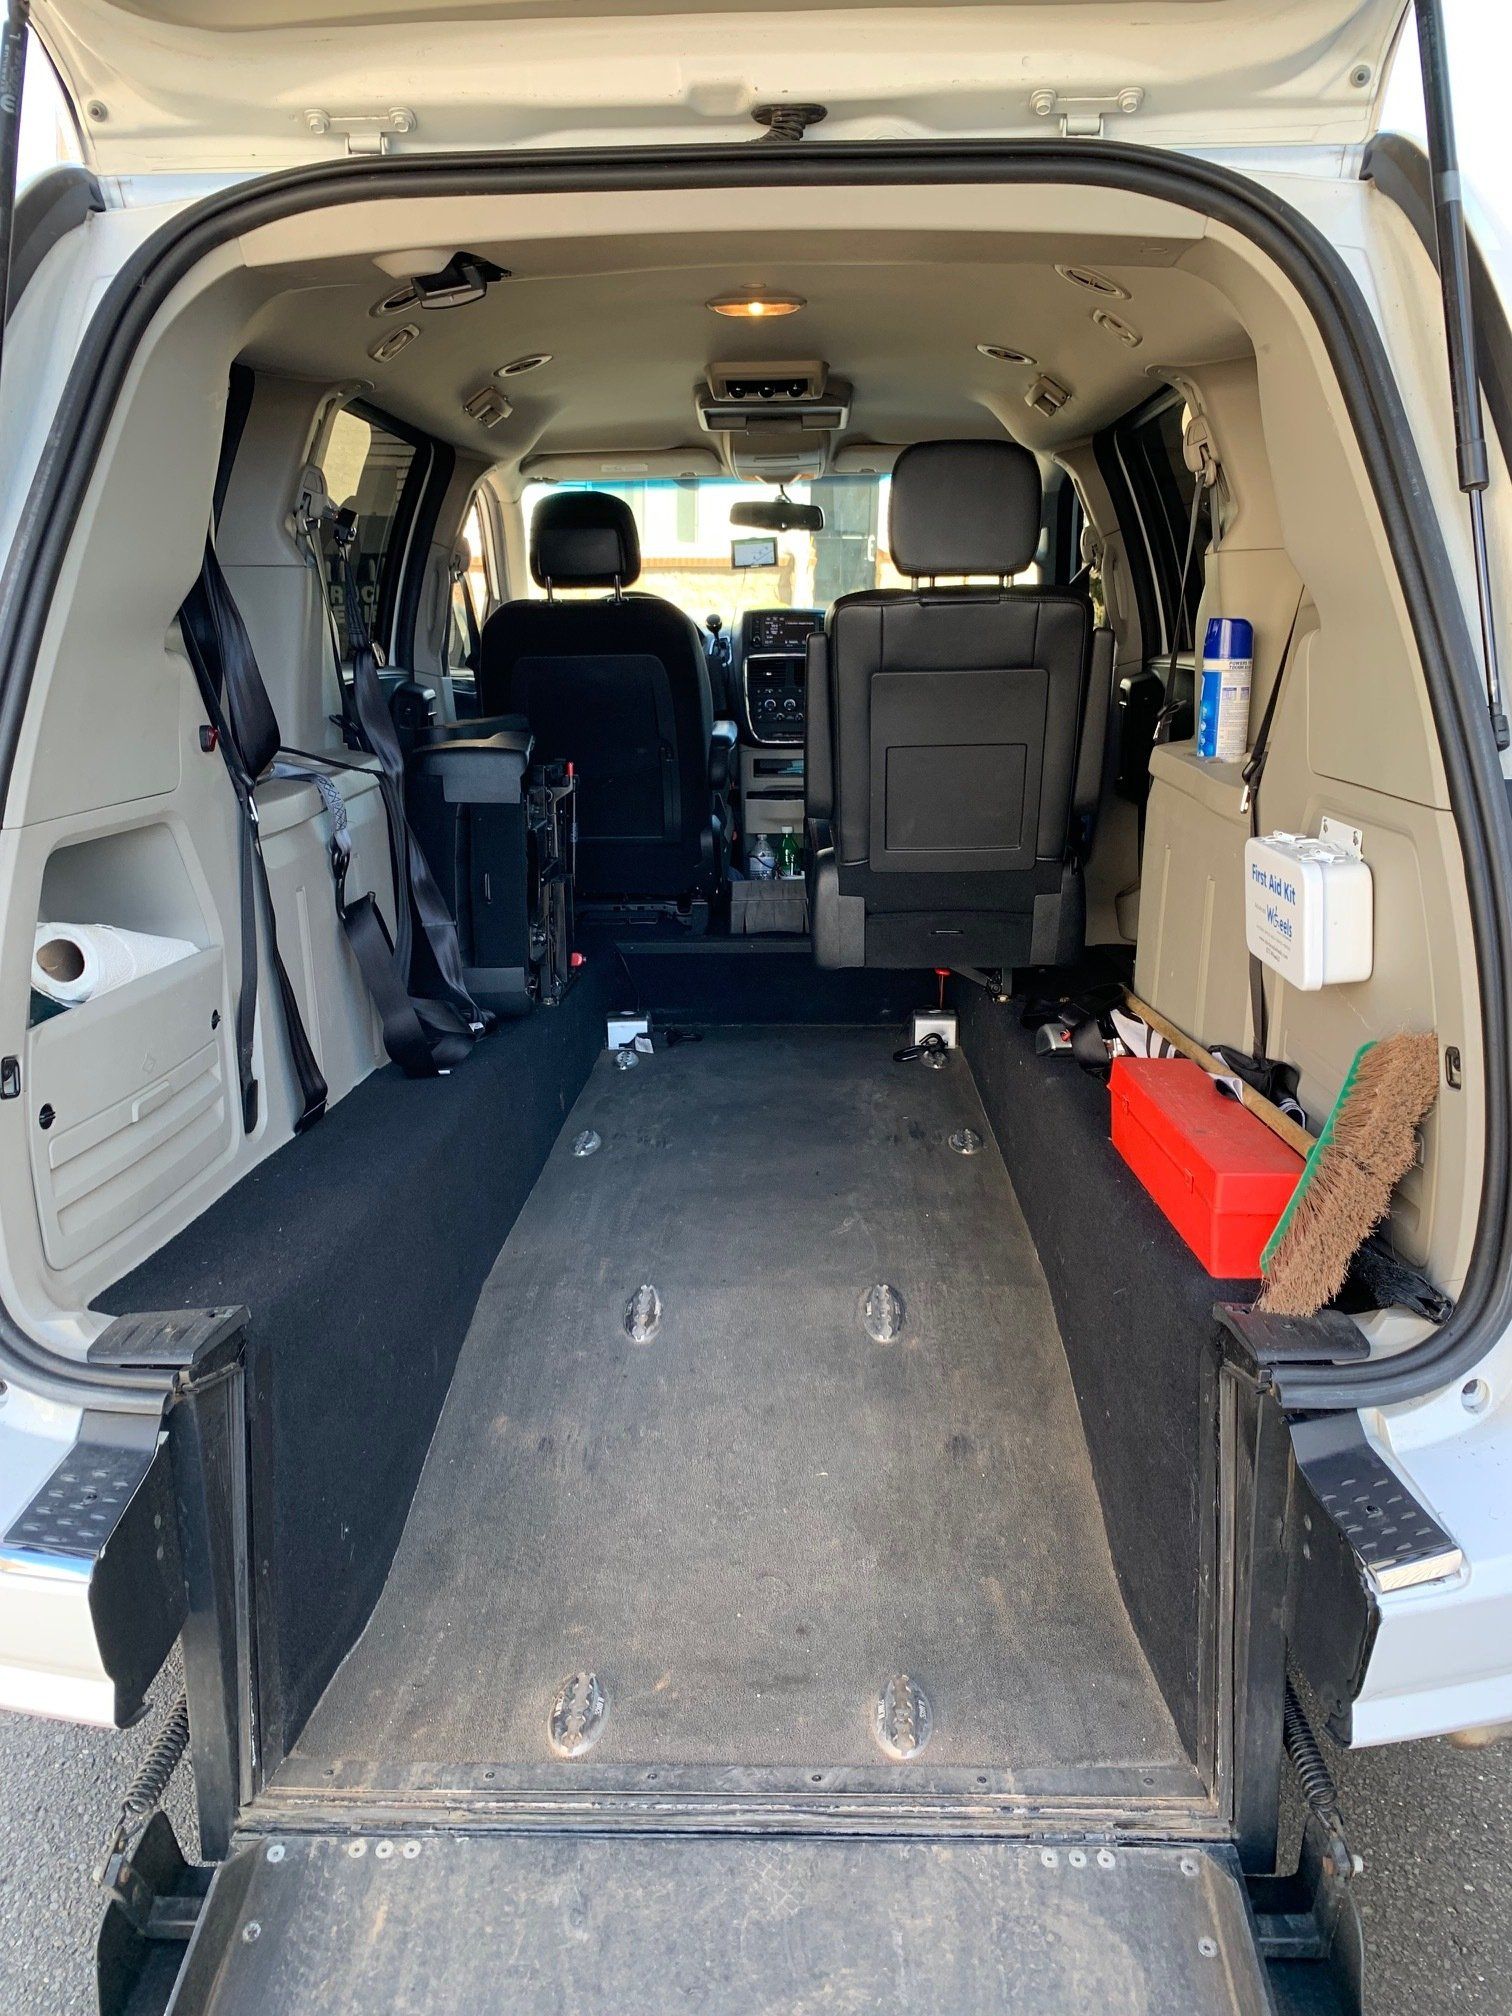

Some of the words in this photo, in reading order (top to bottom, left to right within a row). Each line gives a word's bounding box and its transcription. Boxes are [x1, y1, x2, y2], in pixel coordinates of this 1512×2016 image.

[1252, 863, 1268, 887] First
[1269, 874, 1282, 897] Aid
[1284, 881, 1296, 906] Kit
